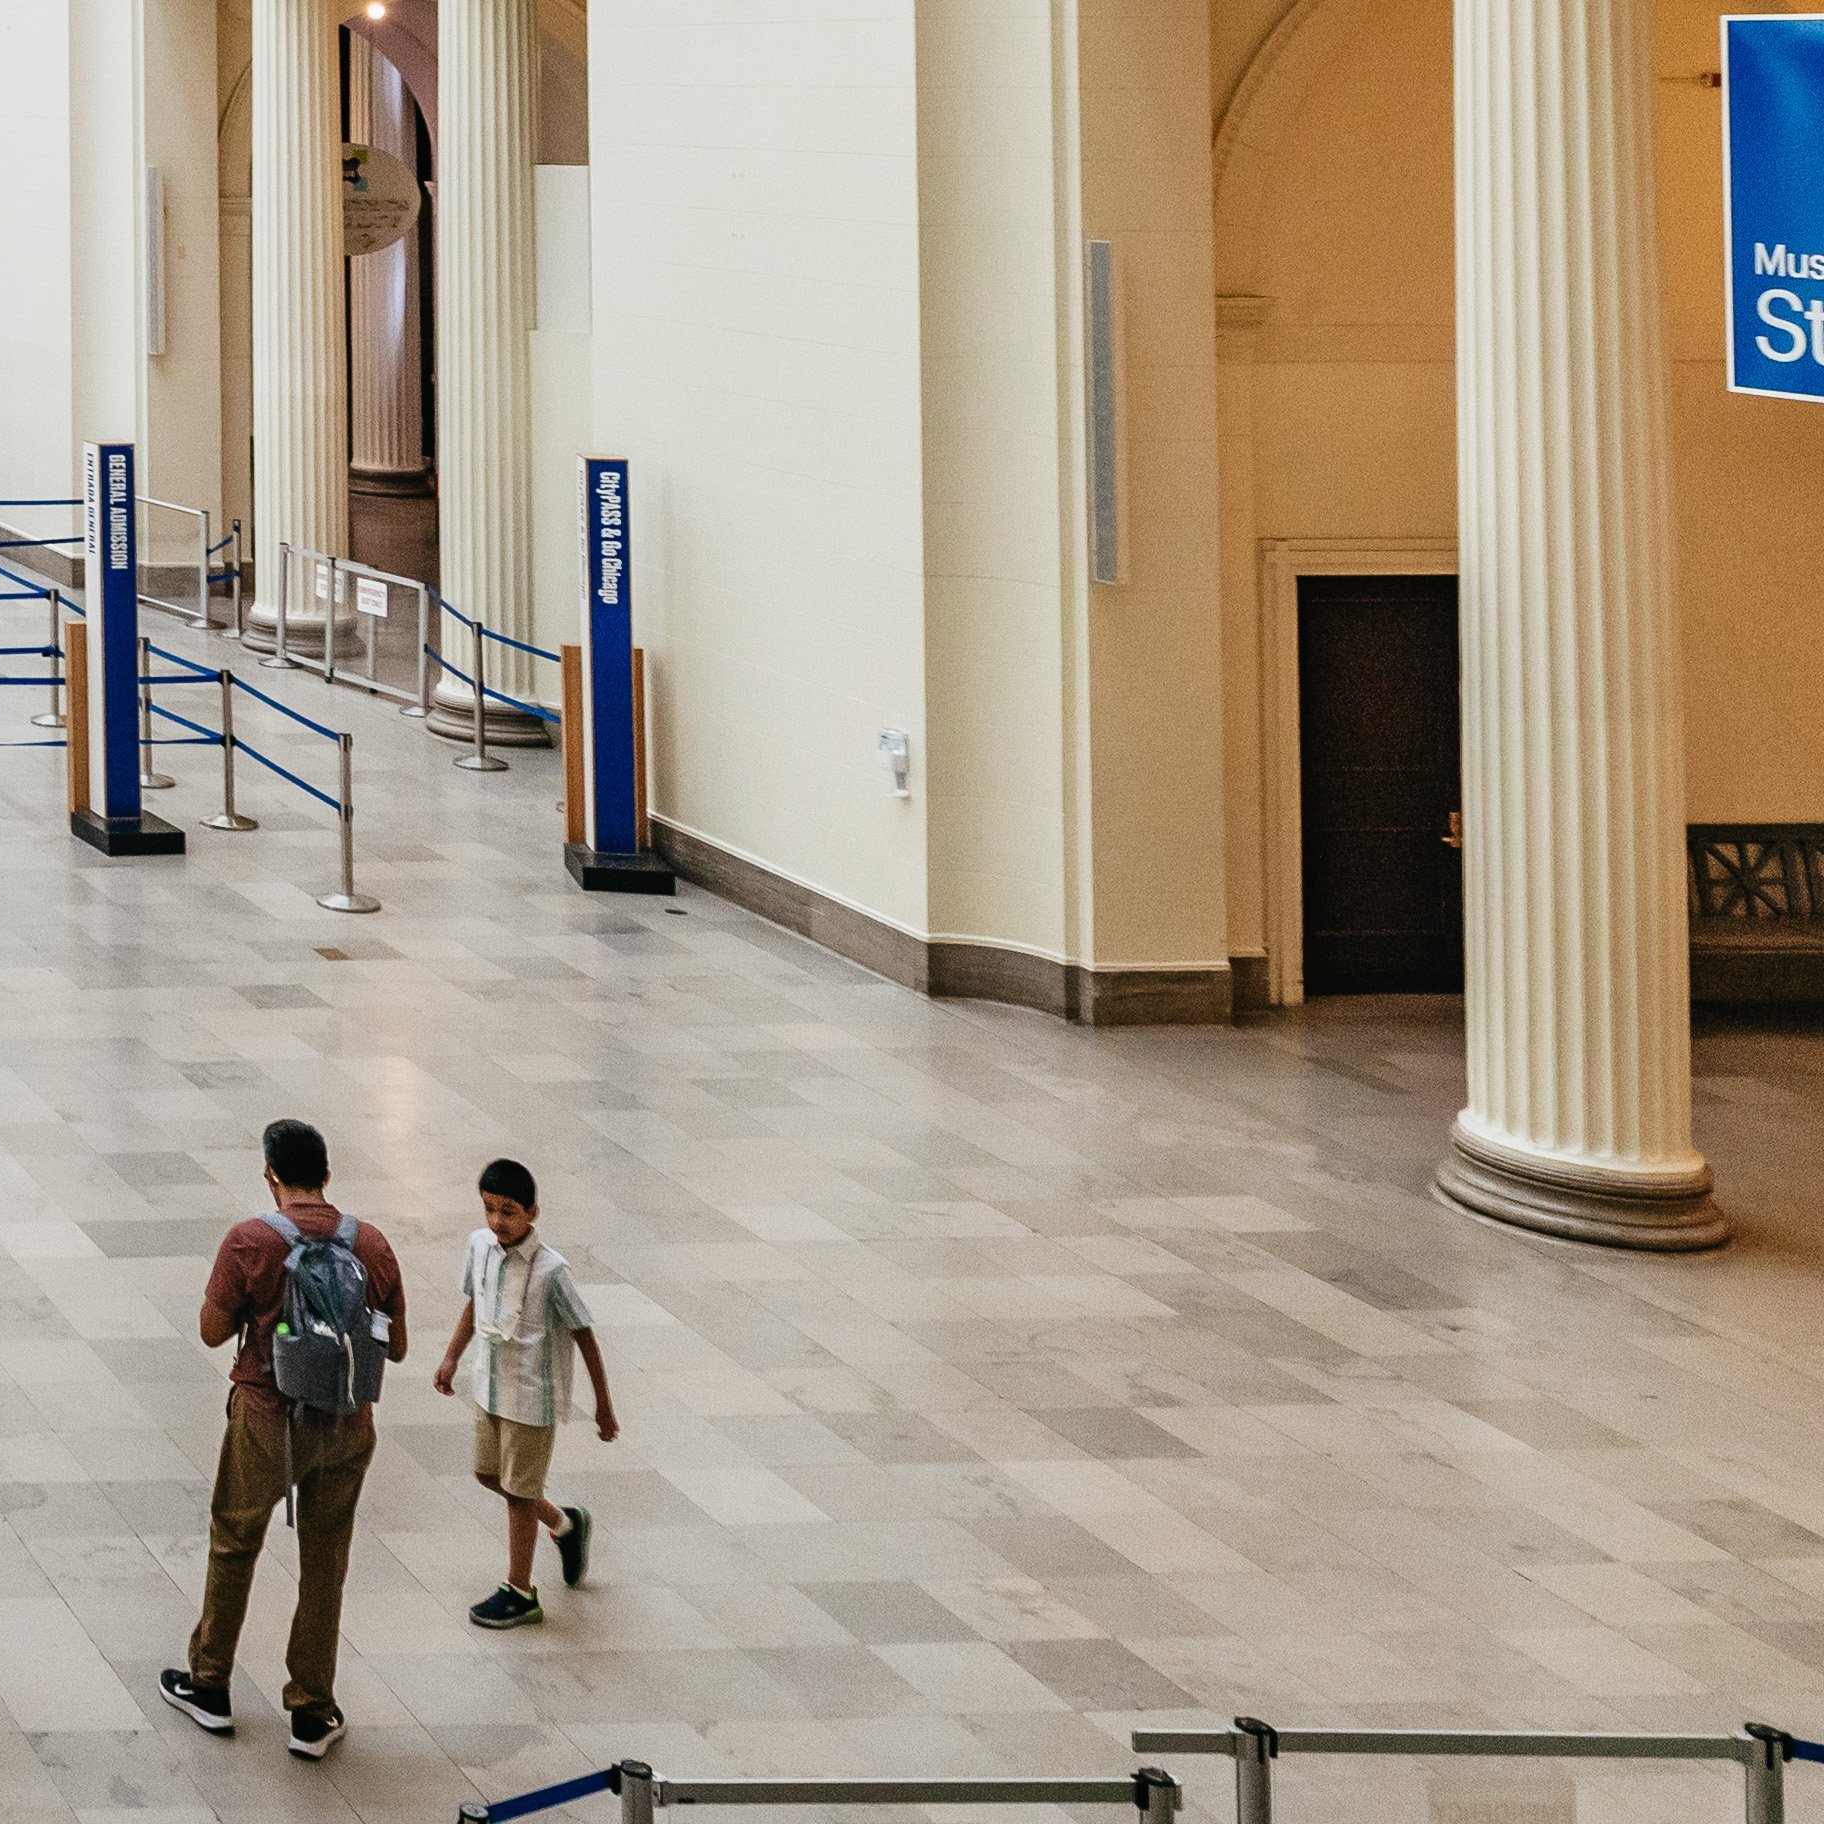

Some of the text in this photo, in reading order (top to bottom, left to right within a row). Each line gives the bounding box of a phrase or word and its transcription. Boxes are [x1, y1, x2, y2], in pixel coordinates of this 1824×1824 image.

[1754, 242, 1824, 281] Mus
[1755, 288, 1824, 367] St
[108, 454, 128, 570] GENERAL ADMISSION
[596, 471, 623, 605] CityPASS & Go Chicago
